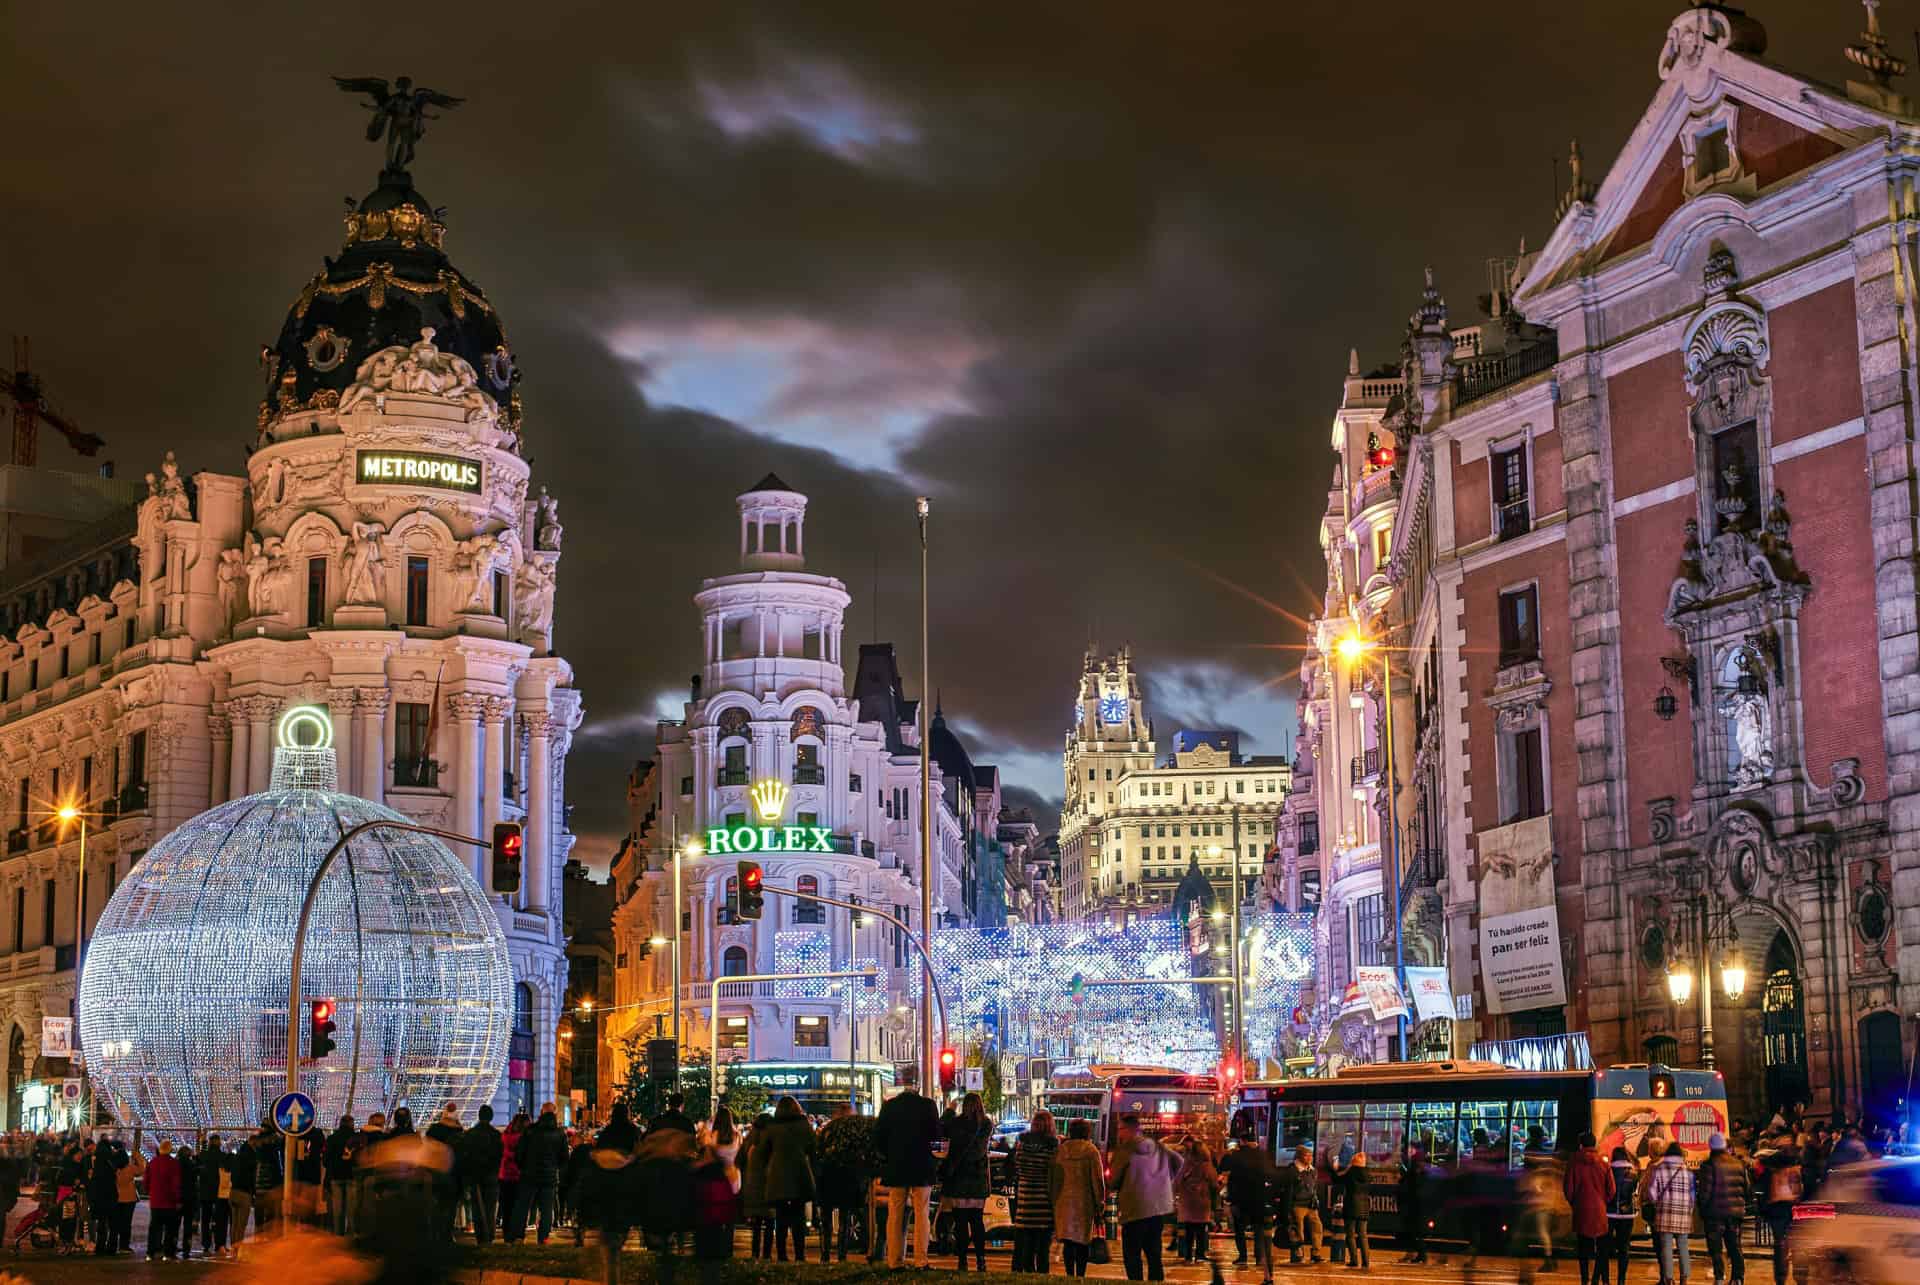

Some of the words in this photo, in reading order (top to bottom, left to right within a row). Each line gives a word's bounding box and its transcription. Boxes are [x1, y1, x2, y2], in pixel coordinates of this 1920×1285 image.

[364, 458, 477, 484] METROPOLIS
[707, 826, 833, 854] ROLEX
[1514, 939, 1528, 950] ser
[1529, 934, 1550, 947] feliz
[735, 1073, 809, 1086] GRASSY
[1657, 1081, 1665, 1097] 2
[1684, 1087, 1702, 1096] 1010
